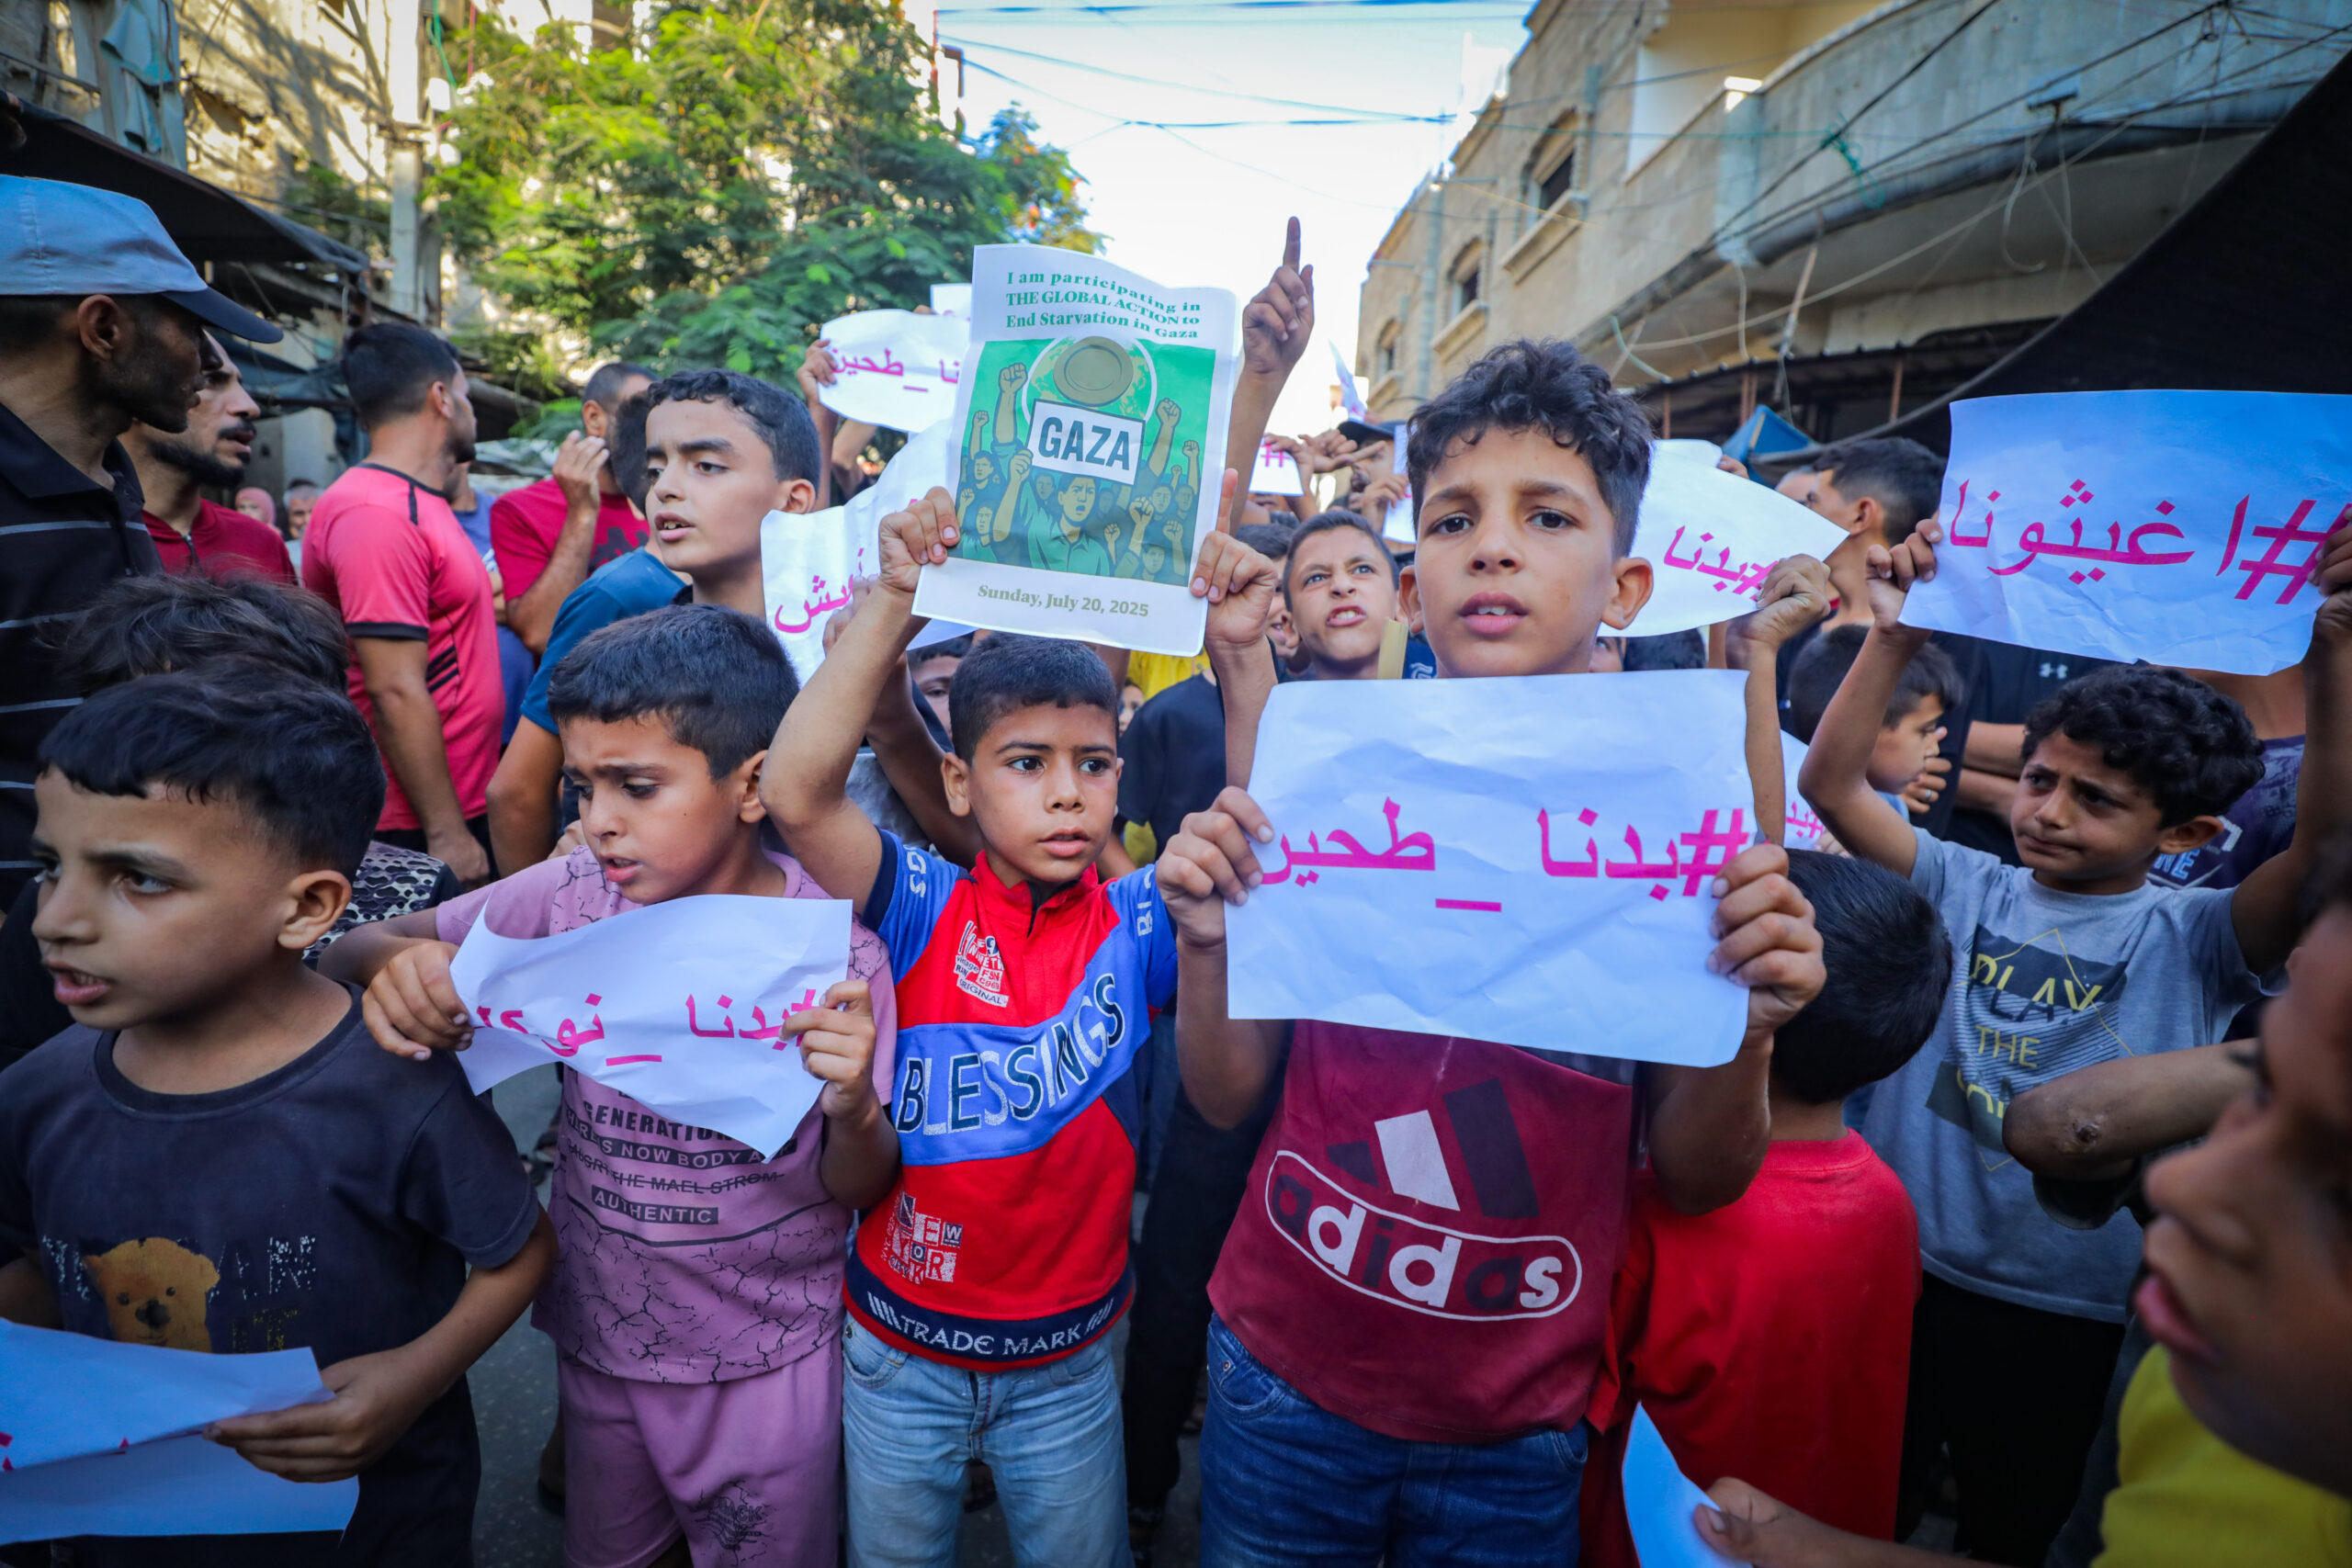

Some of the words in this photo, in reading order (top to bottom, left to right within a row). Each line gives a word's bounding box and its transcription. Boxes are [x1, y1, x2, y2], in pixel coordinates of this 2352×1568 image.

[1005, 290, 1039, 306] THE
[1041, 290, 1112, 306] GLOBAL
[1114, 299, 1181, 325] ACTION
[1182, 316, 1201, 325] to
[1007, 272, 1013, 285] I
[1019, 273, 1045, 284] am
[1050, 273, 1177, 314] participating
[1182, 302, 1201, 312] in
[1006, 312, 1035, 328] End
[1039, 311, 1129, 328] Starvation
[1133, 318, 1151, 333] in
[1155, 328, 1199, 338] Gaza
[1038, 416, 1130, 471] GAZA
[978, 584, 1043, 607] Sunday,
[1046, 593, 1079, 613] July
[1081, 597, 1105, 615] 20,
[1109, 600, 1149, 617] 2025
[897, 973, 1126, 1135] BLESSINGS
[1975, 1025, 2041, 1068] THE
[621, 1142, 671, 1163] NOW
[678, 1151, 742, 1169] BODY
[650, 1176, 704, 1194] MAEL
[711, 1170, 778, 1195] STROM
[594, 1191, 712, 1224] AUTHENTIC
[1272, 1174, 1563, 1311] adidas
[900, 1314, 995, 1356] TRADE
[1001, 1322, 1082, 1356] MARK
